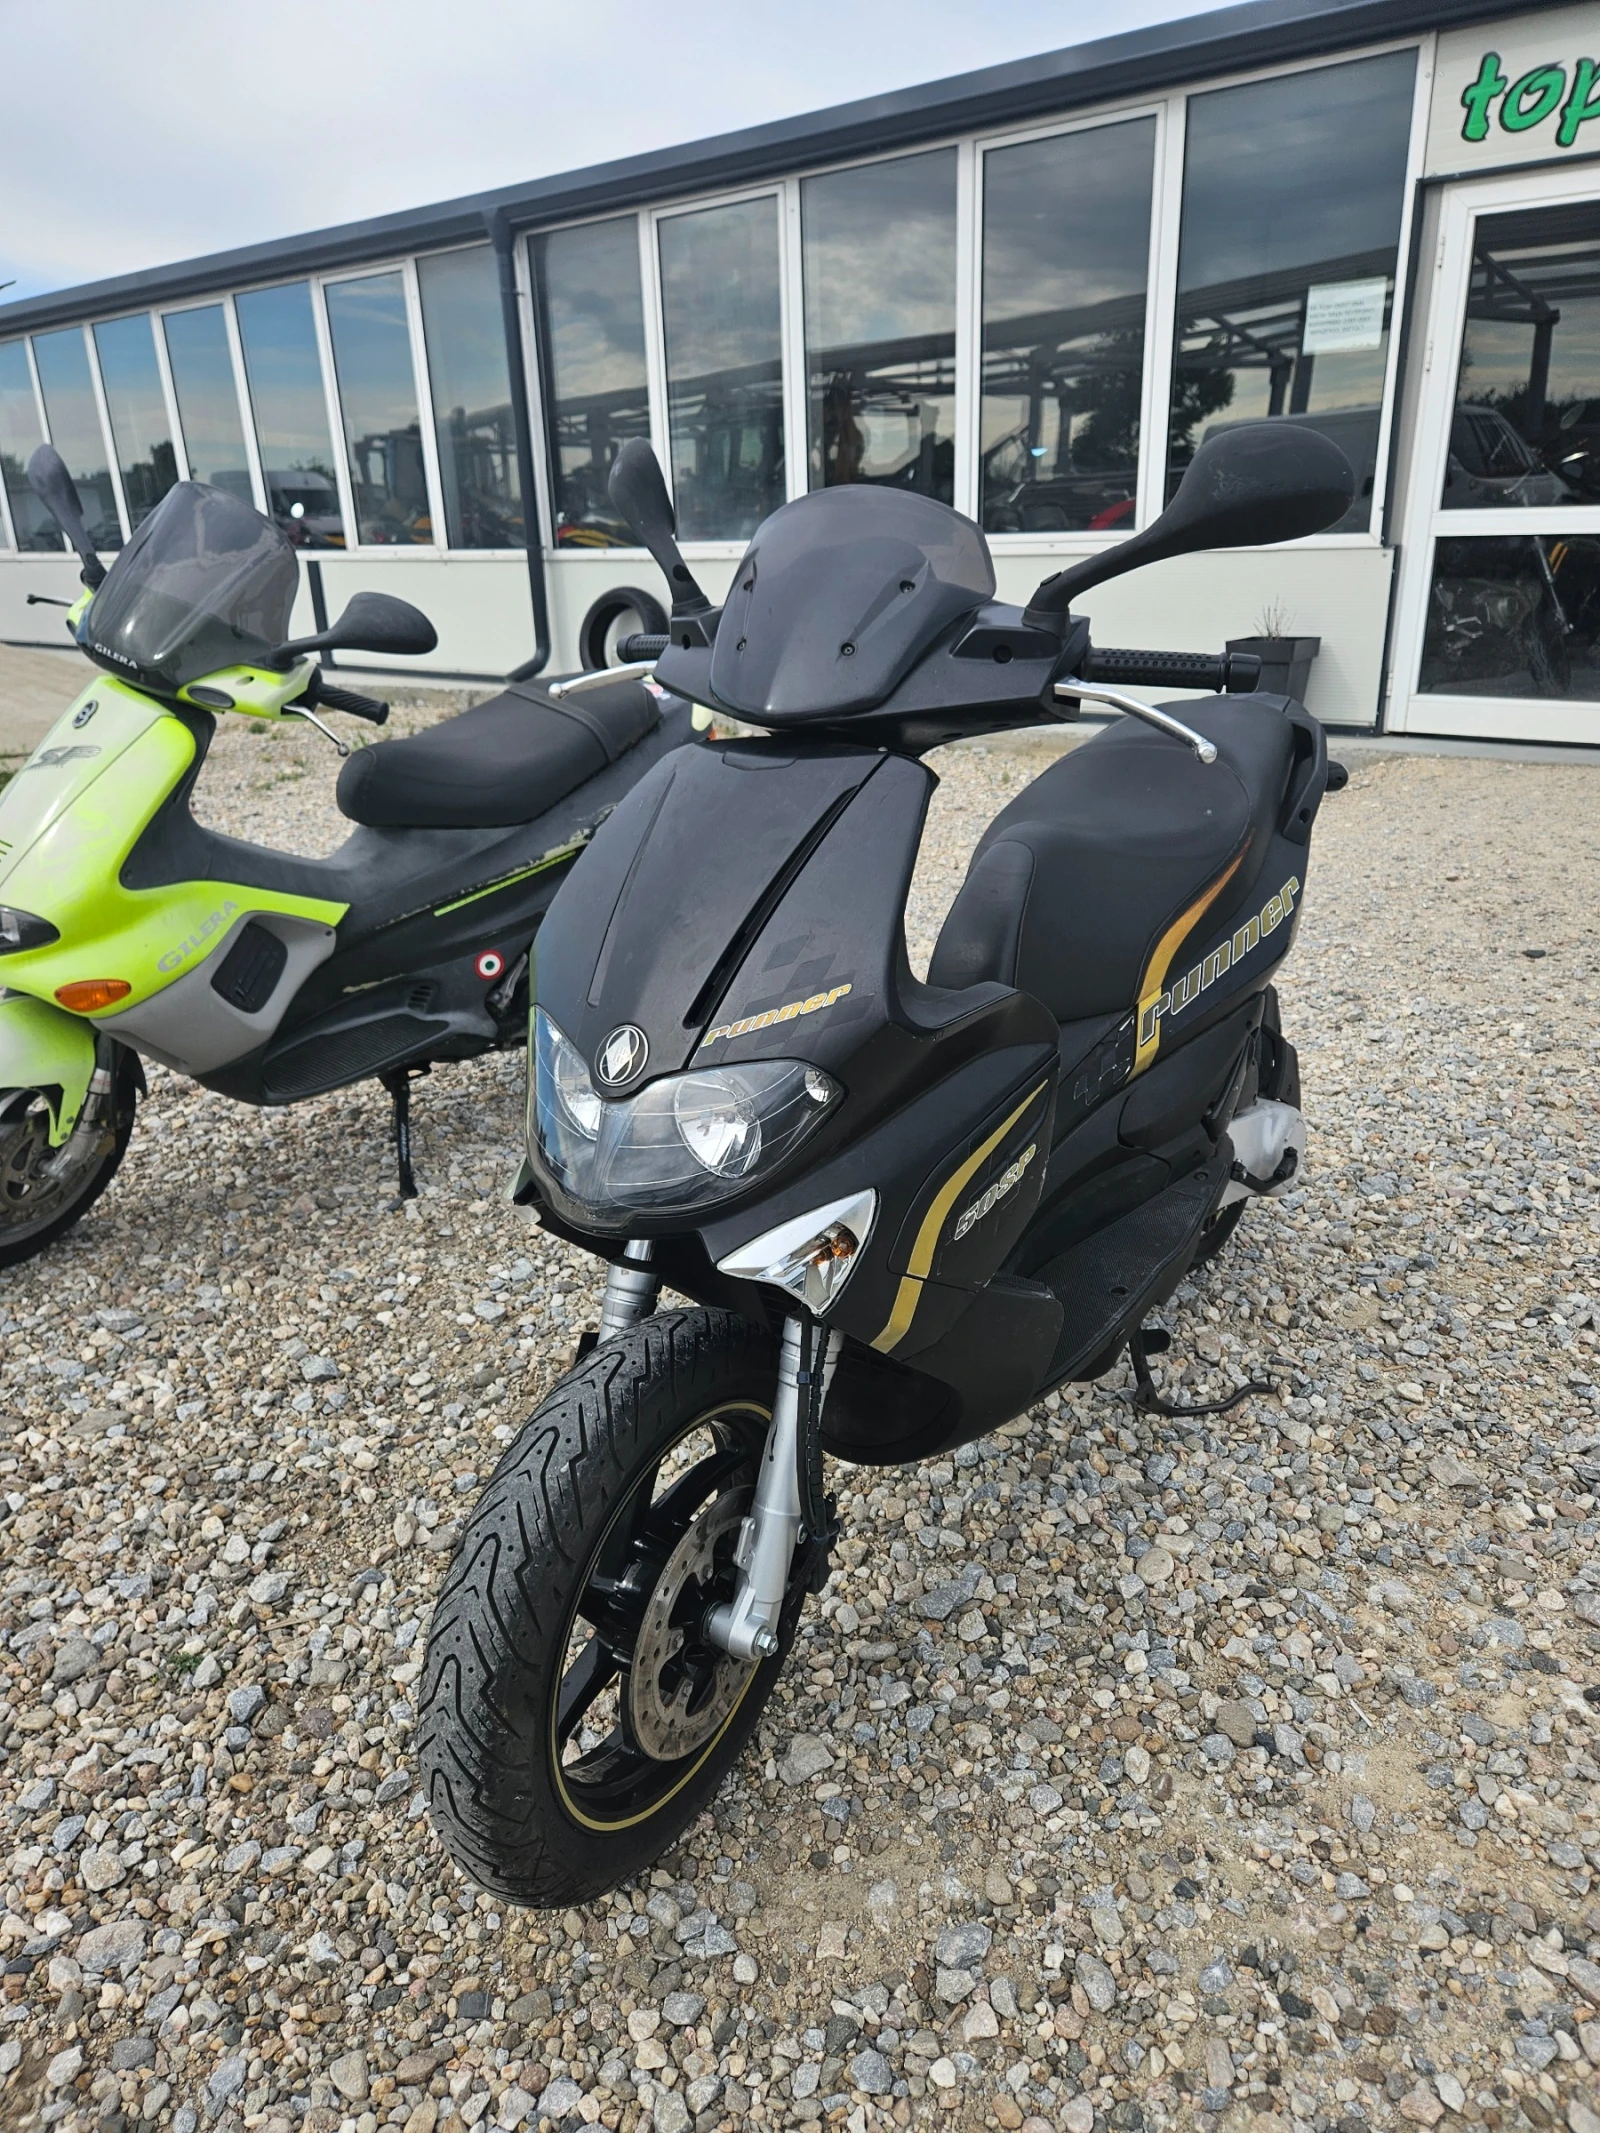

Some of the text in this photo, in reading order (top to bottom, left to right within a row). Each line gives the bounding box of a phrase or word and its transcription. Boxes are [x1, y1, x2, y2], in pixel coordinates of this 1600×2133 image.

[1460, 51, 1600, 147] top
[94, 642, 138, 670] GILERA
[157, 899, 238, 973] GILERA
[1139, 876, 1300, 1046] runner
[701, 983, 852, 1048] runner
